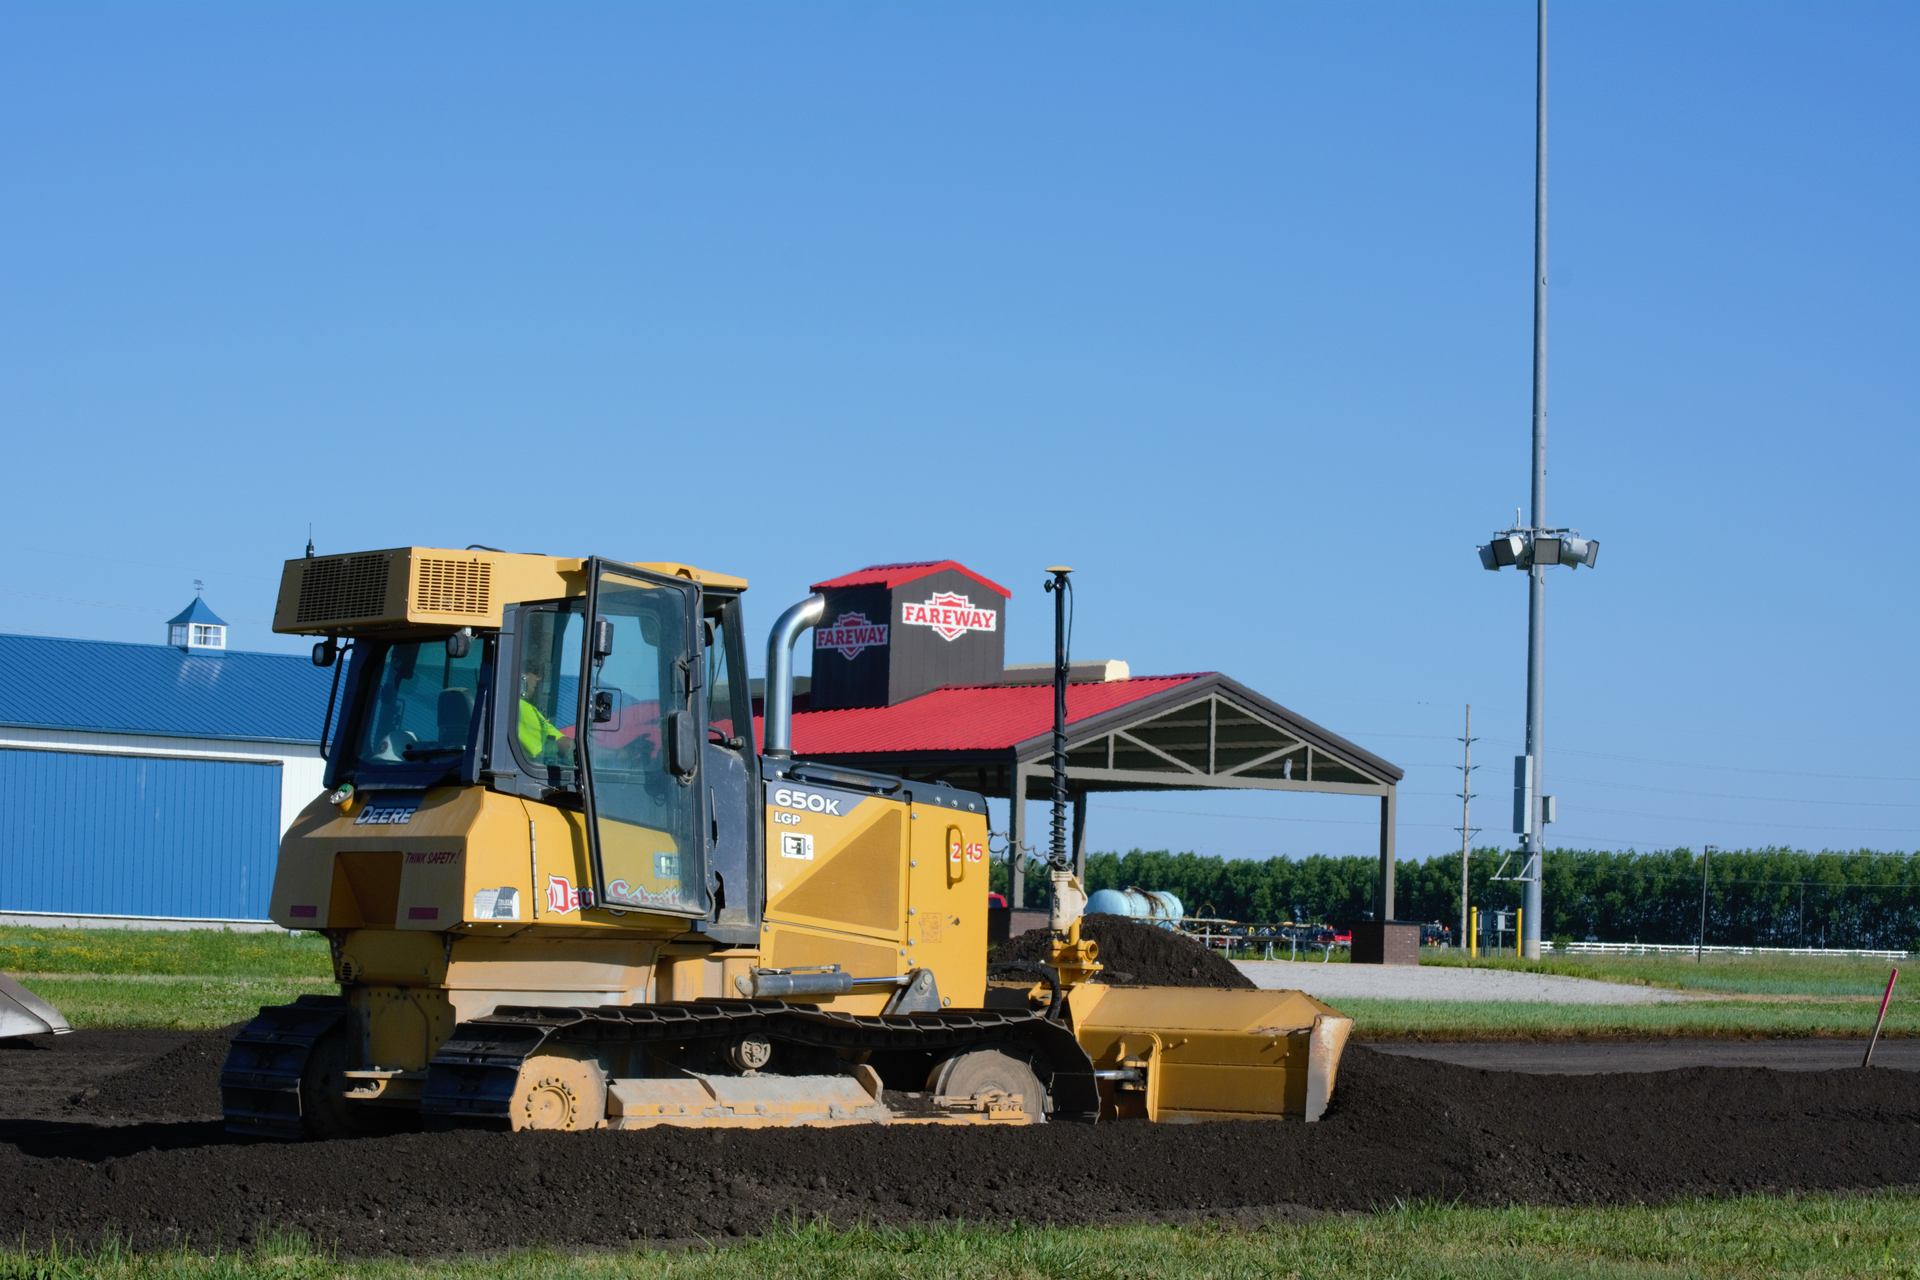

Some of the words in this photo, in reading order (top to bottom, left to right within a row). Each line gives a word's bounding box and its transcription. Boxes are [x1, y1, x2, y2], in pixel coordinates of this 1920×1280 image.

[903, 604, 995, 629] FAREWAY
[816, 626, 887, 648] FAREWAY
[774, 787, 841, 817] 650K
[353, 805, 418, 825] DEERE
[774, 810, 801, 826] LGP
[405, 851, 428, 864] THINK
[427, 848, 463, 865] SAFETY!
[544, 873, 600, 915] Dav
